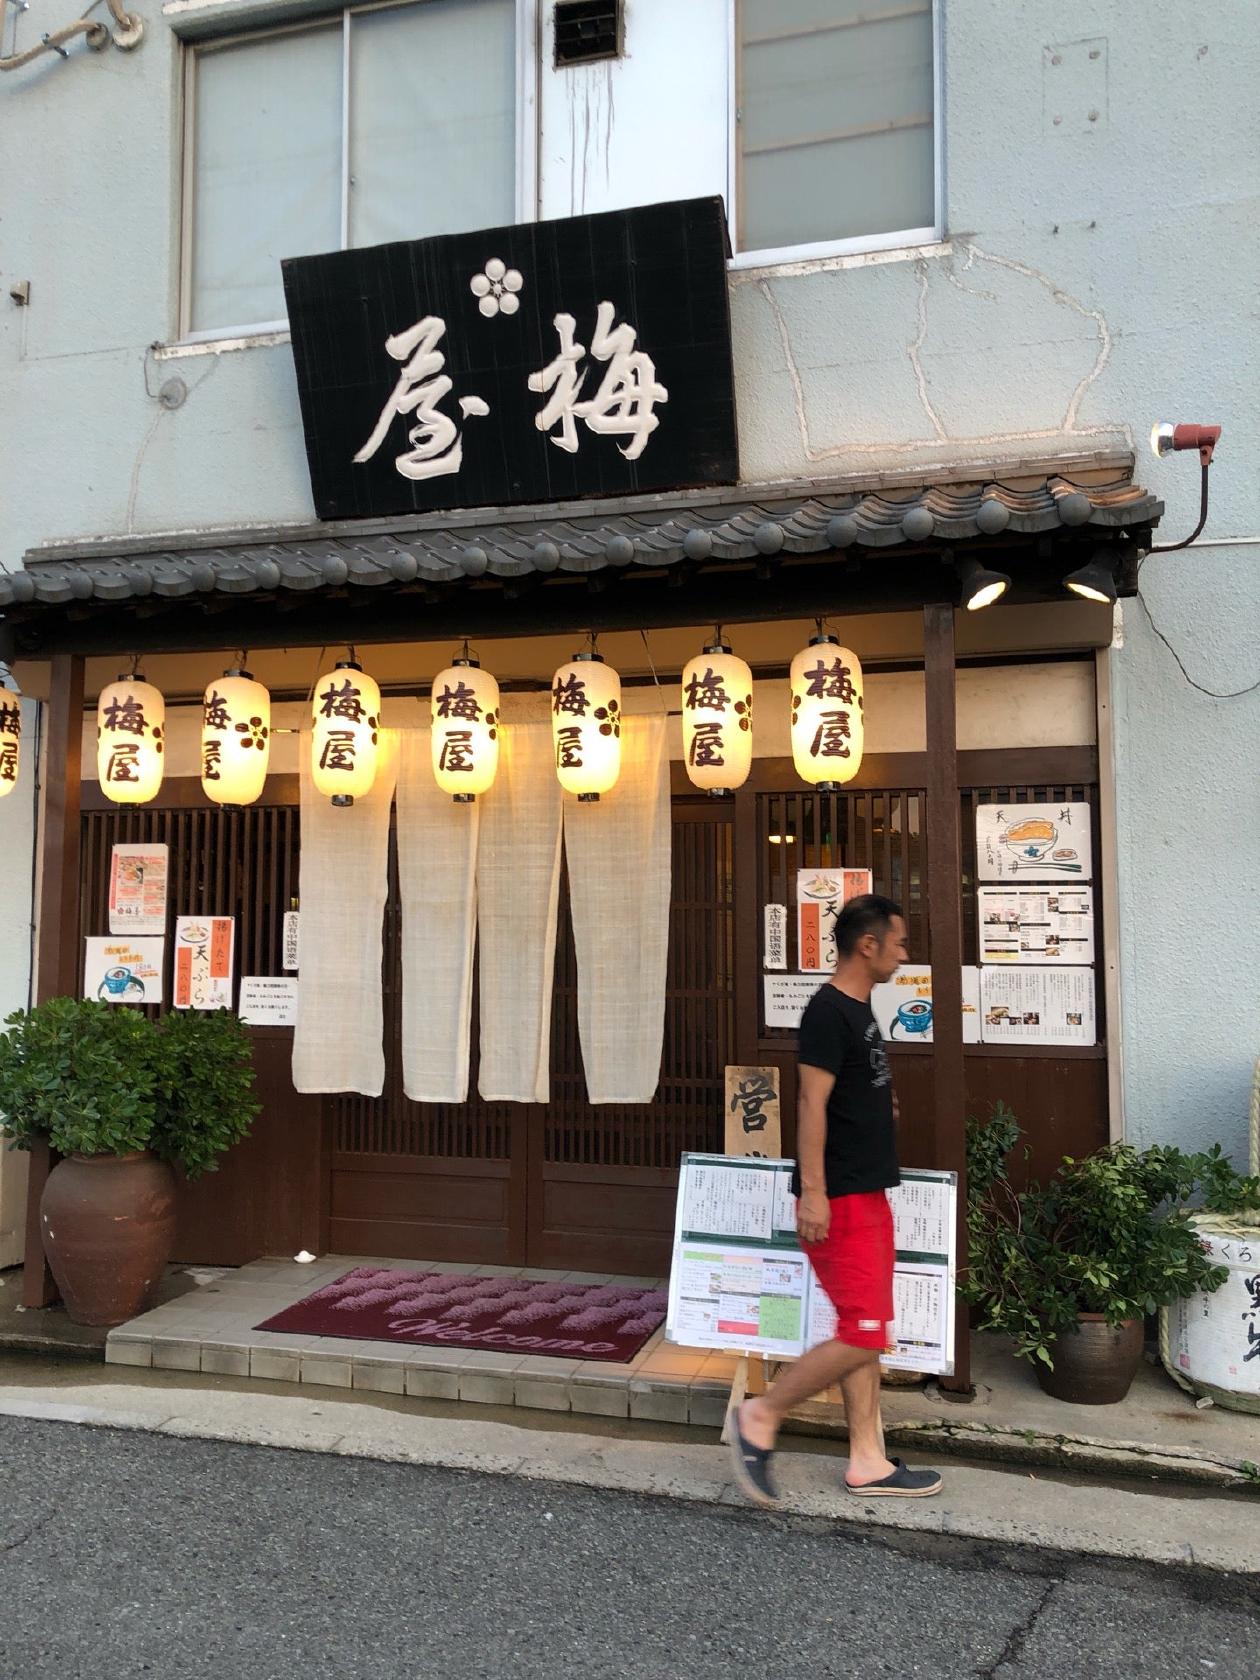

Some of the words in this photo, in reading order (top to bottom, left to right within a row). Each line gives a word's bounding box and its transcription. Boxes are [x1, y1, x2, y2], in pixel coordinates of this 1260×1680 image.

[104, 696, 149, 782] 梅屋
[319, 679, 366, 771] 梅屋
[436, 682, 483, 772] 梅屋
[553, 673, 591, 769] 梅屋
[684, 668, 731, 767] 梅屋
[803, 657, 857, 759] 梅屋
[192, 944, 209, 1005] 天ぷら
[731, 1074, 777, 1158] 営
[387, 1318, 620, 1352] Welcome
